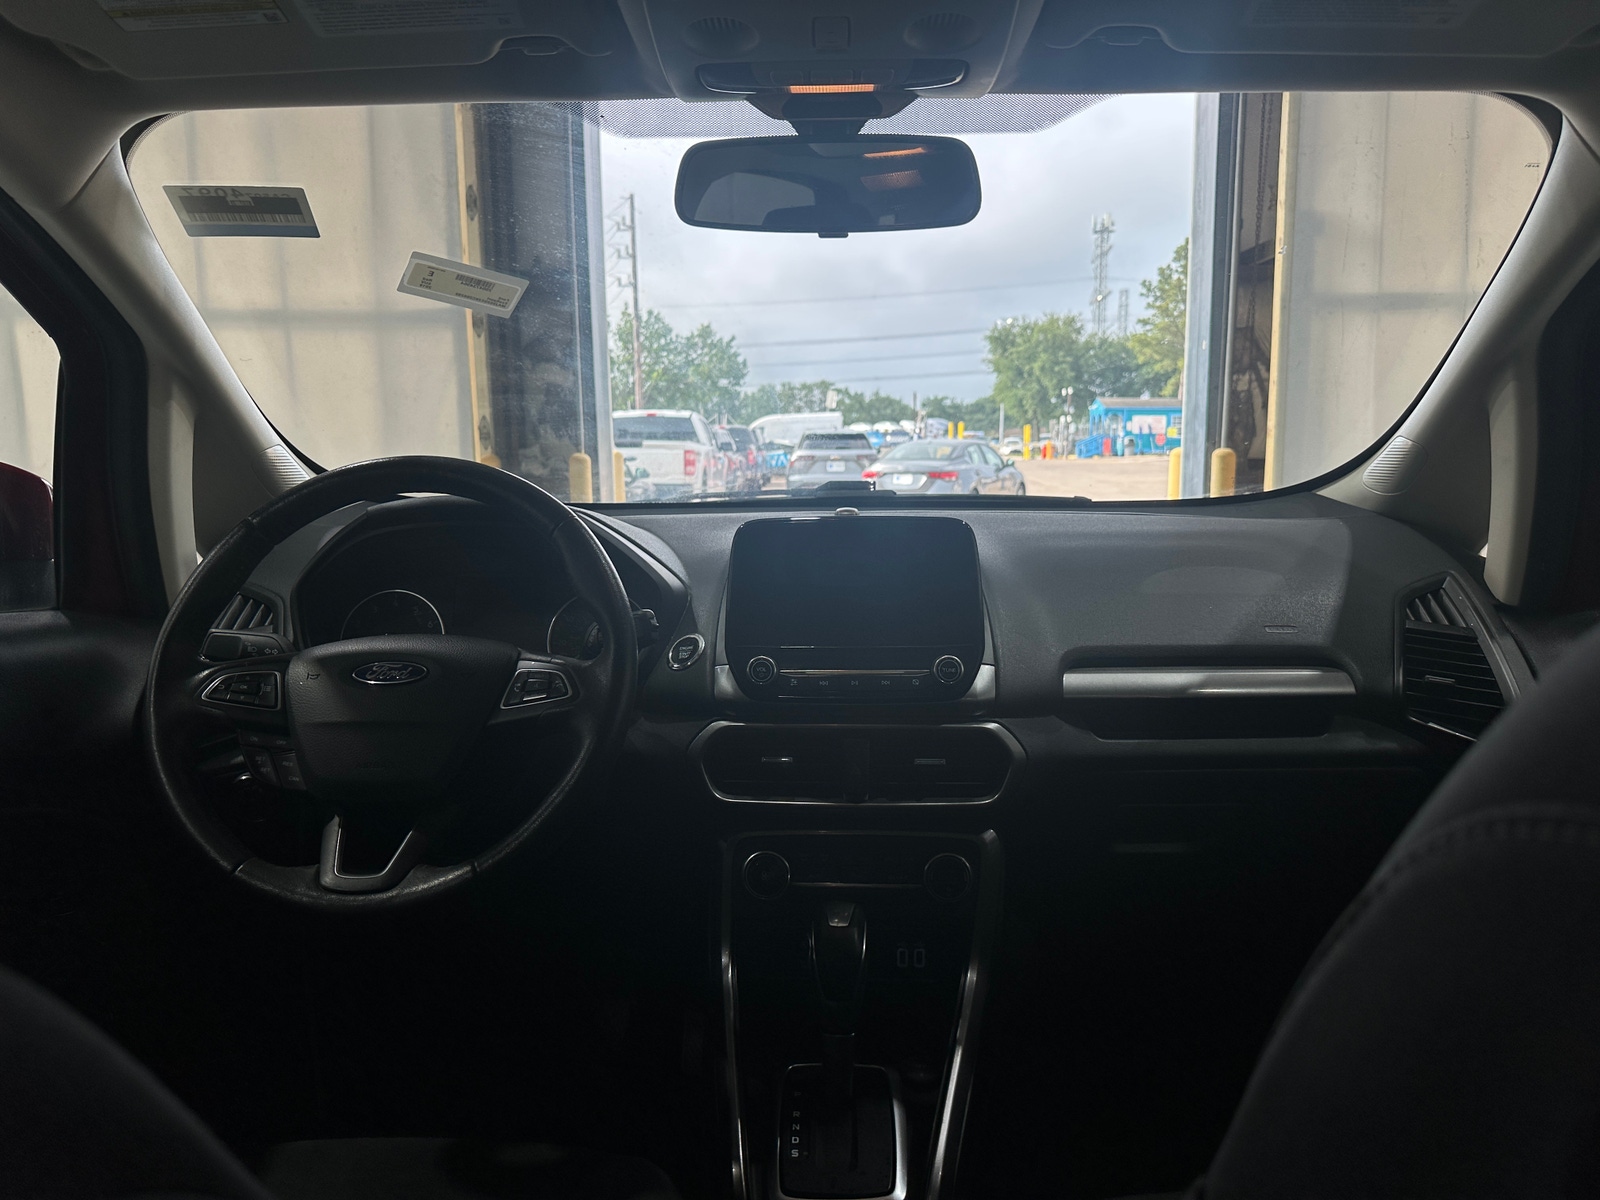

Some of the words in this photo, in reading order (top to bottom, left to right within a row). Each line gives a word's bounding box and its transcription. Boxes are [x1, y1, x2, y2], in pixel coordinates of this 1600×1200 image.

[365, 663, 413, 679] Ford
[792, 1123, 800, 1131] N
[791, 1136, 799, 1144] D
[791, 1149, 799, 1157] S
